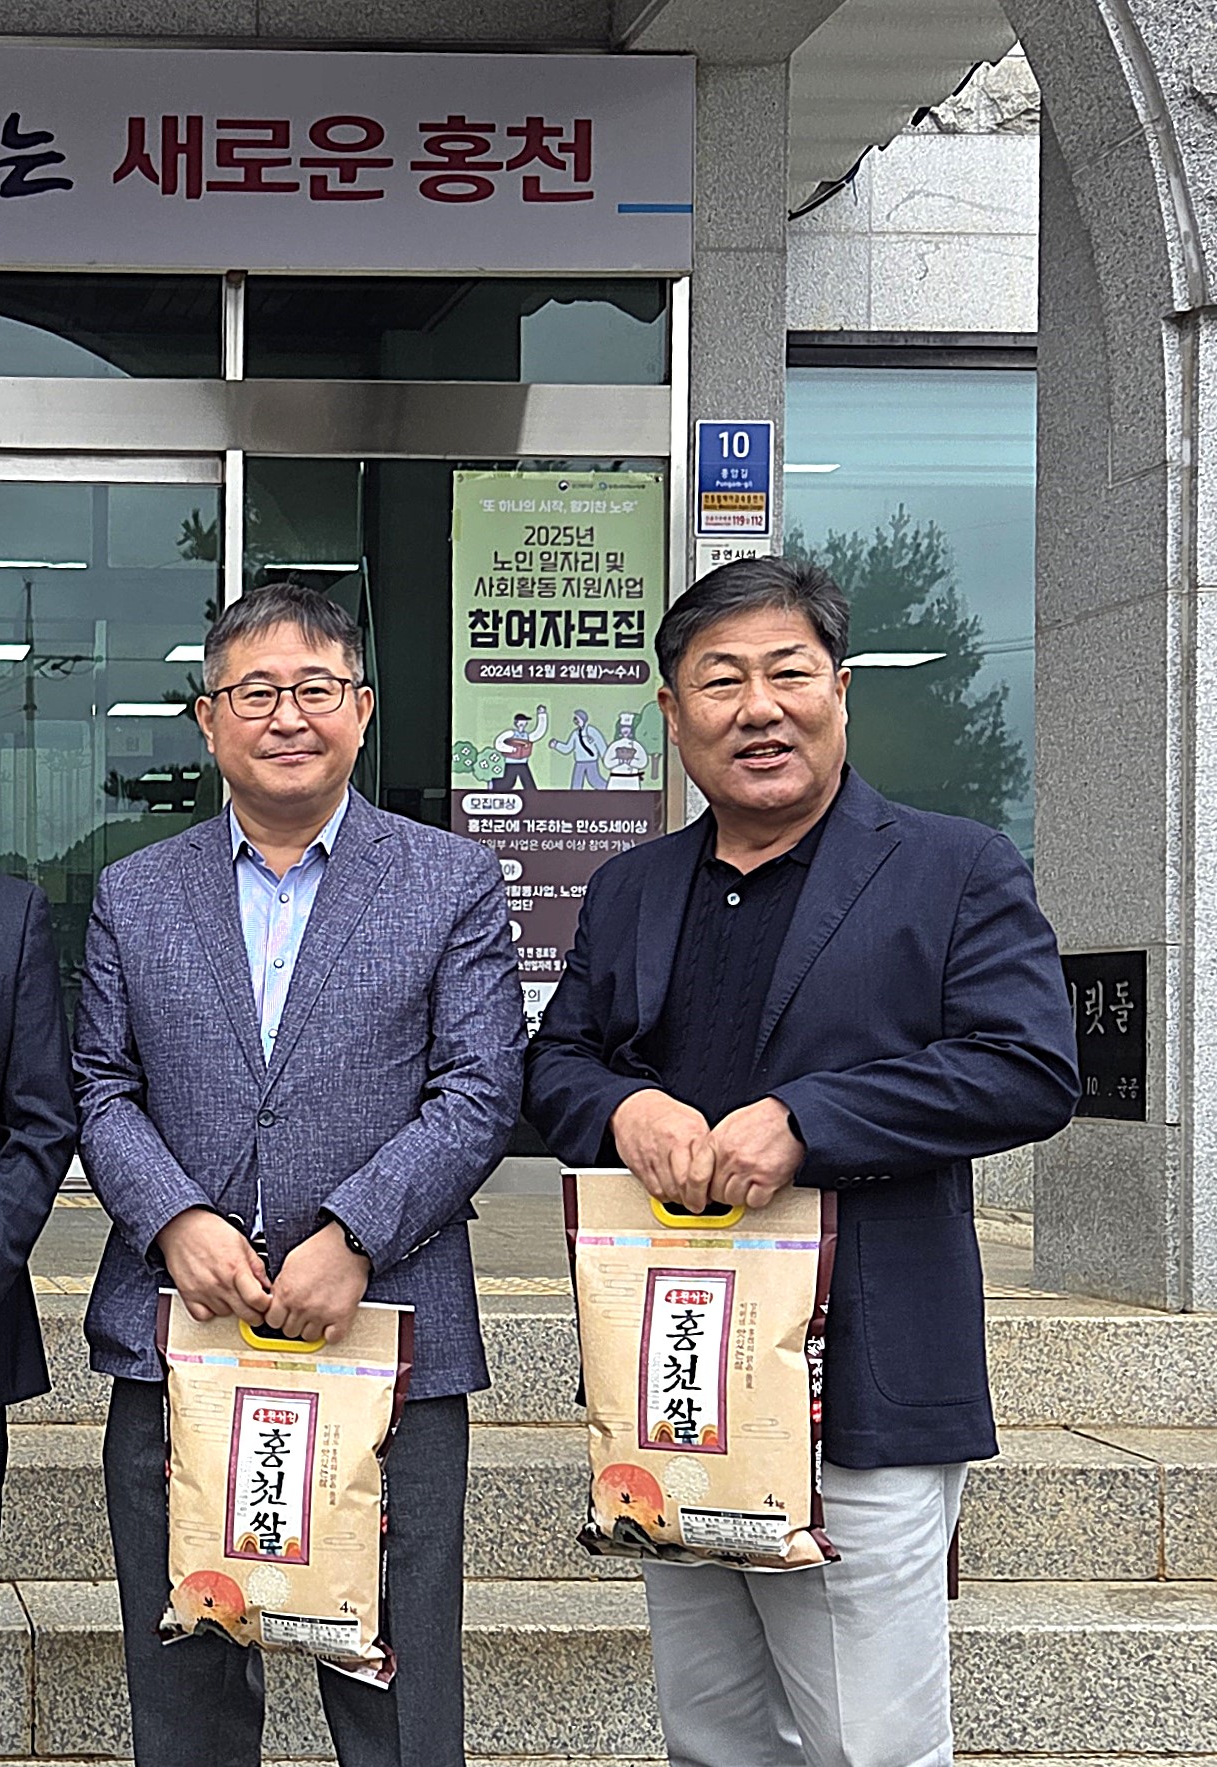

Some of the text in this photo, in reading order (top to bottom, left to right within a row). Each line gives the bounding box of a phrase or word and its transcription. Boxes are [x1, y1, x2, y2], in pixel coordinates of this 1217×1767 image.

[112, 115, 394, 202] 새로운
[410, 115, 595, 203] 홍천
[718, 431, 750, 458] 10
[499, 500, 536, 513] 하나의
[524, 525, 595, 547] 2025년
[492, 551, 624, 573] 노인 일자리 및
[474, 577, 644, 599] 사회활동 지원사업
[468, 608, 645, 649] 참여자모집
[480, 664, 524, 678] 2024년
[528, 664, 556, 678] 12월
[470, 797, 516, 811] 모집대상
[467, 819, 648, 835] 홍천군에 거주하는 만65세이상
[509, 839, 540, 850] 사업은
[541, 839, 564, 851] 60세
[566, 839, 586, 851] 이상
[588, 840, 610, 852] 참여
[507, 899, 534, 911] 업단
[662, 1309, 706, 1439] 홍천쌀
[249, 1428, 292, 1550] 홍천쌀
